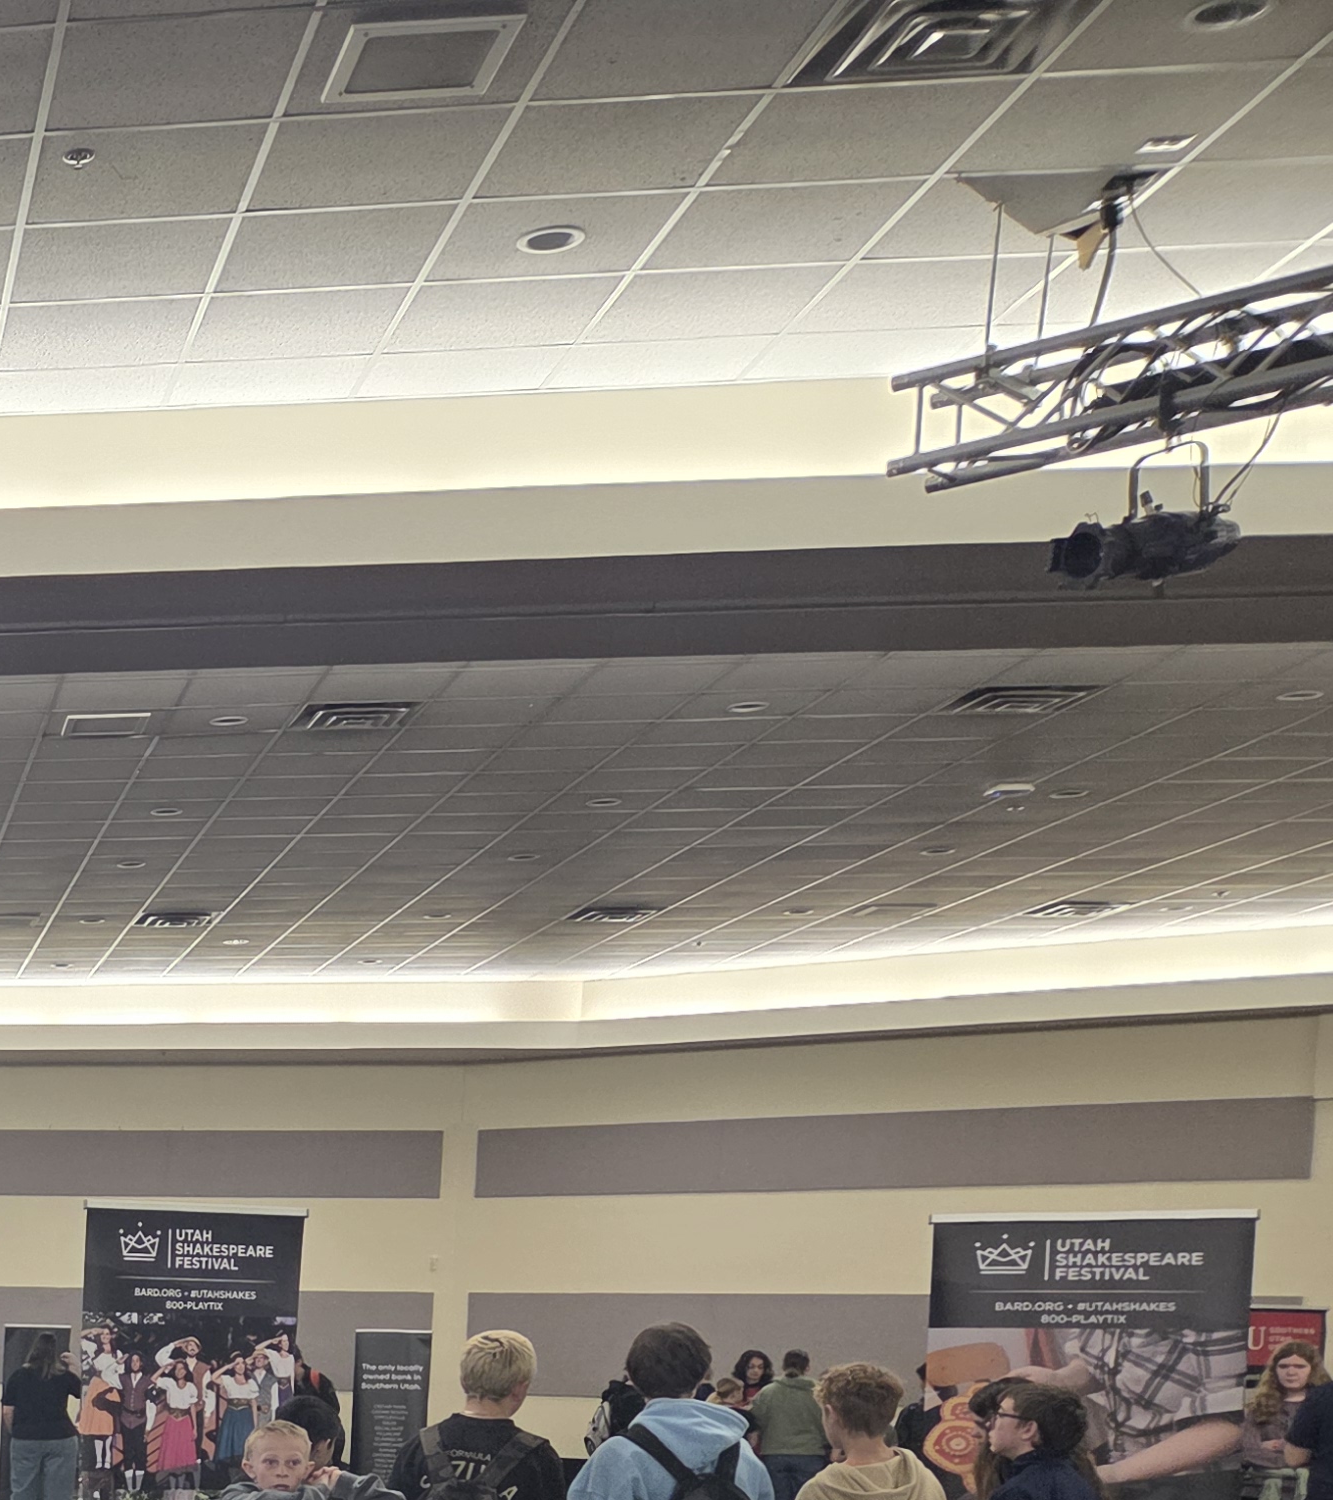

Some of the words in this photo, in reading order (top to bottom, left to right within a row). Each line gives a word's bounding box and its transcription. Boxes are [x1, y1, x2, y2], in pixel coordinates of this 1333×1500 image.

[175, 1228, 213, 1242] UTAH
[175, 1242, 275, 1259] SHAKESPEARE
[1056, 1237, 1112, 1252] UTAH
[174, 1256, 239, 1271] FESTIVAL
[1054, 1251, 1205, 1267] SHAKESPEARE
[1054, 1266, 1151, 1281] FESTIVAL
[133, 1286, 183, 1298] BARD.ORG
[189, 1288, 257, 1300] #UTAHSHAKES
[165, 1300, 224, 1312] 800-PLAYTIX
[994, 1300, 1065, 1312] BARD.ORG
[1076, 1301, 1177, 1312] #UTAHSHAKES
[1039, 1313, 1127, 1325] 800-PLAYTIX
